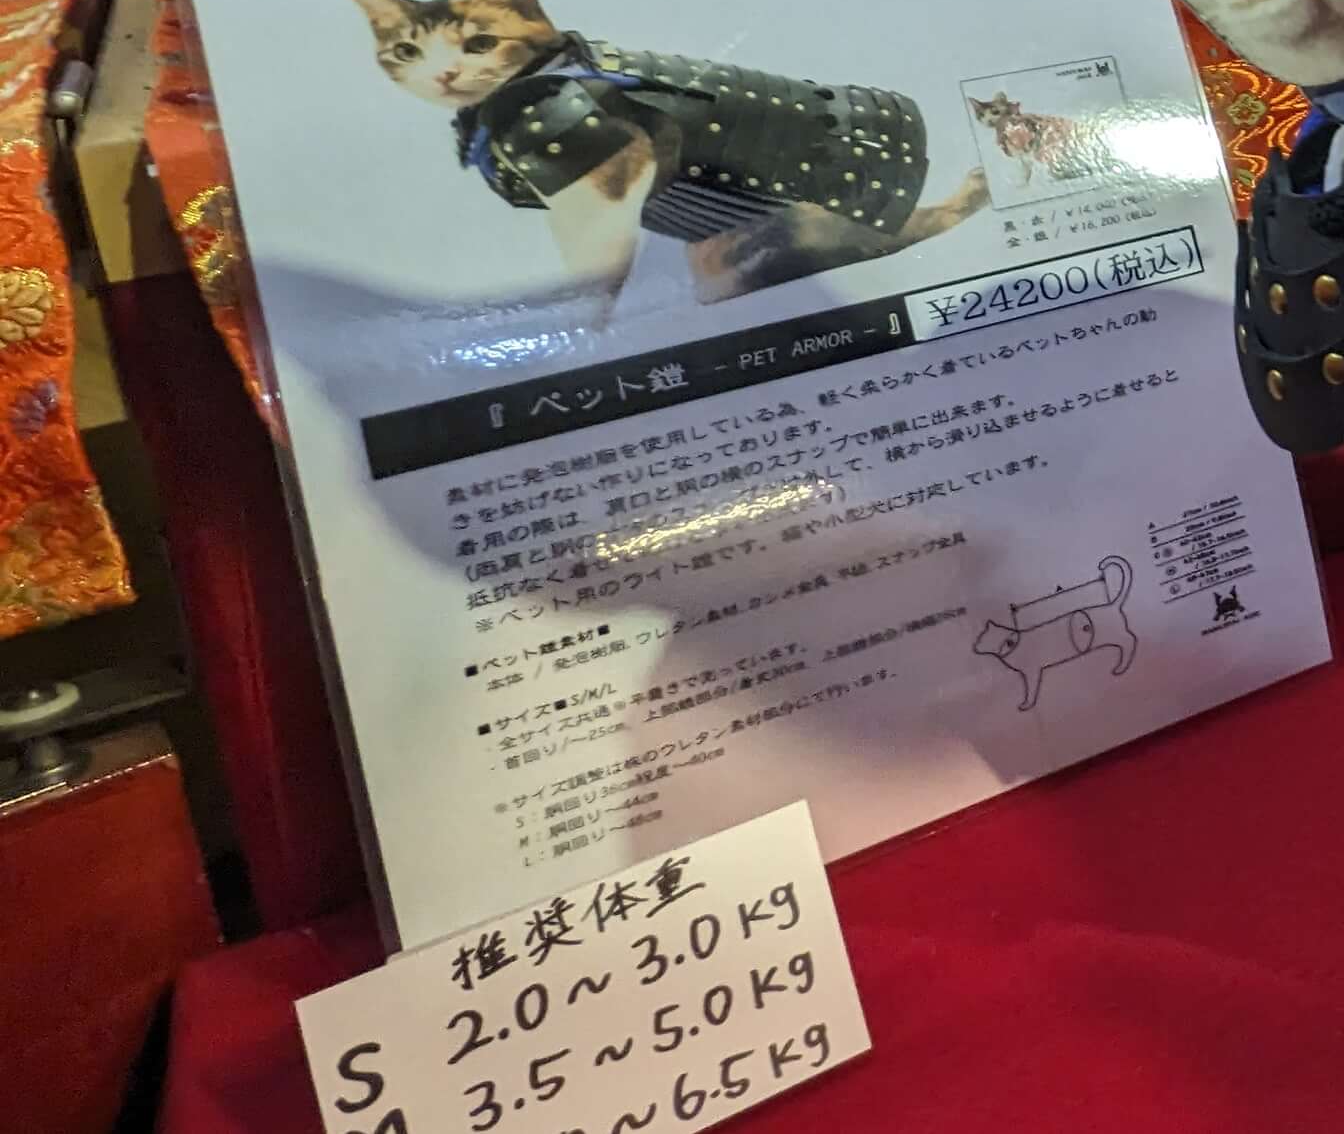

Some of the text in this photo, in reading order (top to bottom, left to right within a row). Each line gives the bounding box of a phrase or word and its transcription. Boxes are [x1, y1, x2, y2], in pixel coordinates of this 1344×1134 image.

[738, 347, 777, 371] PET
[791, 327, 854, 360] ARMOR
[450, 855, 706, 991] 推奨体重
[334, 1041, 385, 1114] S
